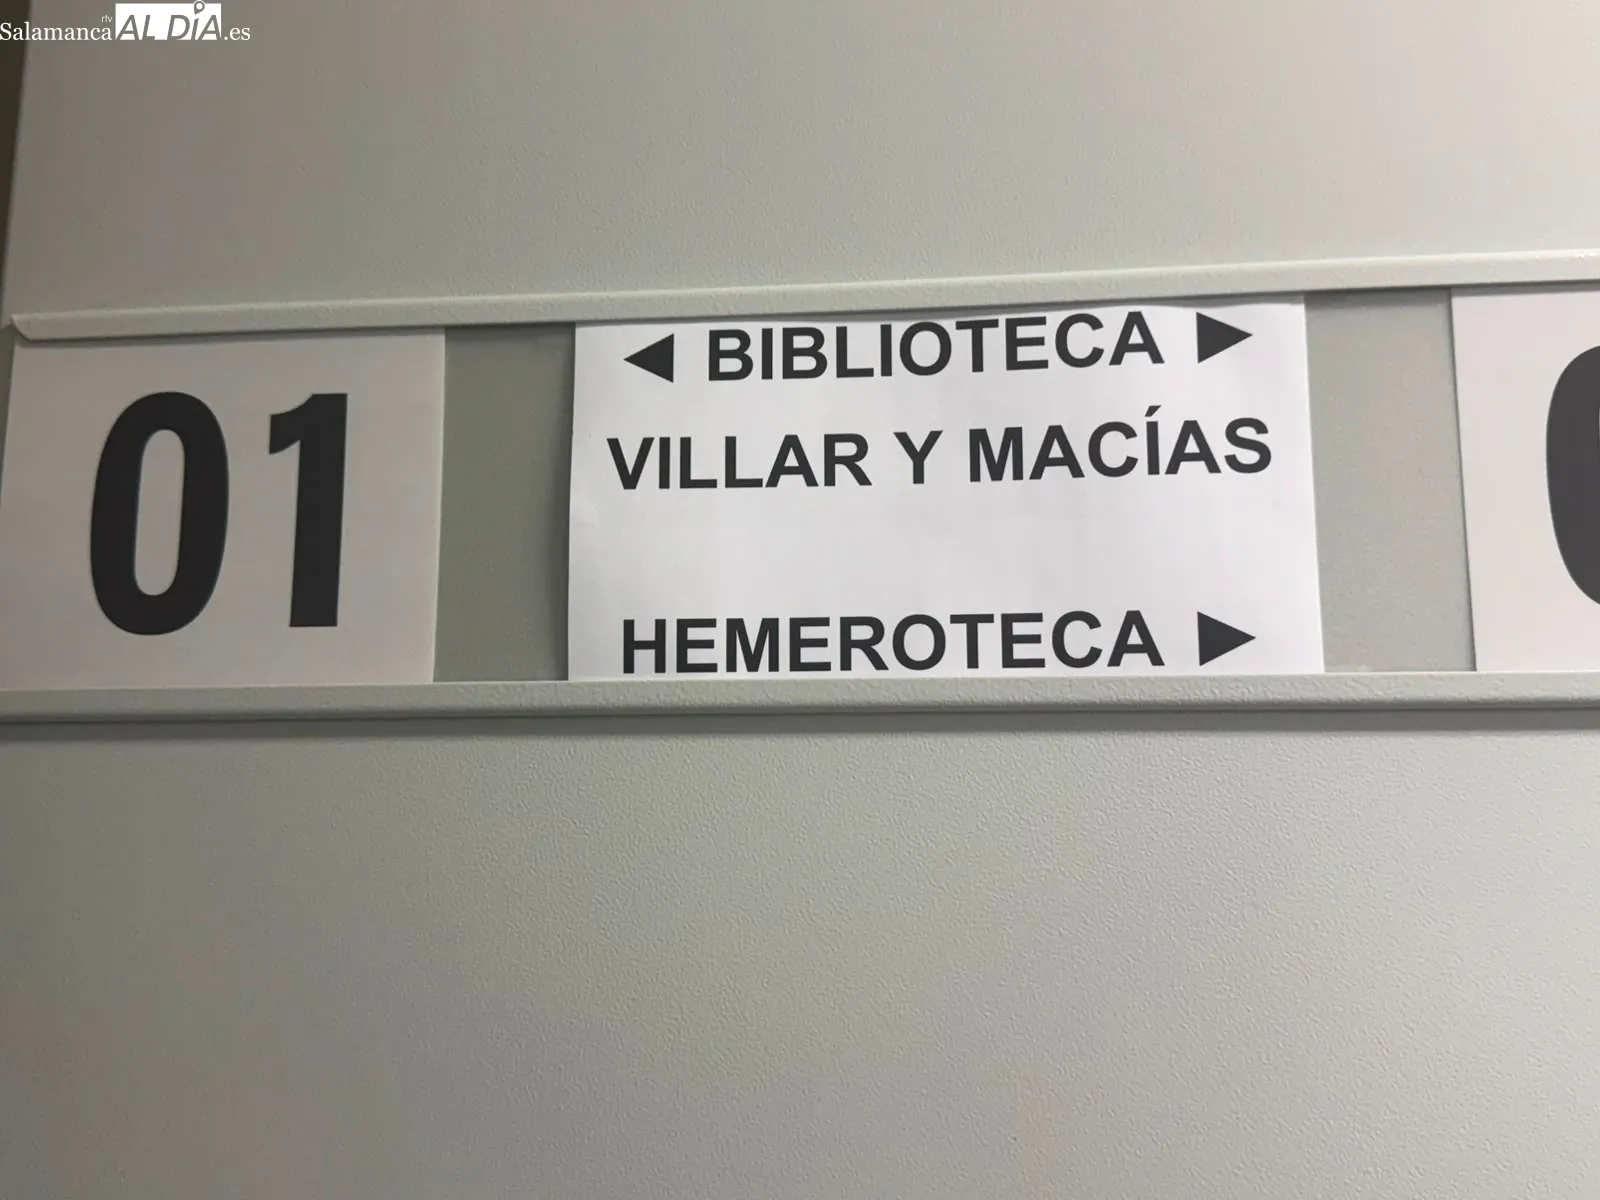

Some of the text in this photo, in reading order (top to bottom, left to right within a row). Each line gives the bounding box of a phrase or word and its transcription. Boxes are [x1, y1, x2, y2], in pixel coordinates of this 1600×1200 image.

[708, 311, 1164, 382] BIBLIOTECA
[607, 405, 1273, 490] VILLAR Y MACÍAS
[89, 391, 348, 636] 01
[623, 610, 1165, 674] HEMEROTECA
